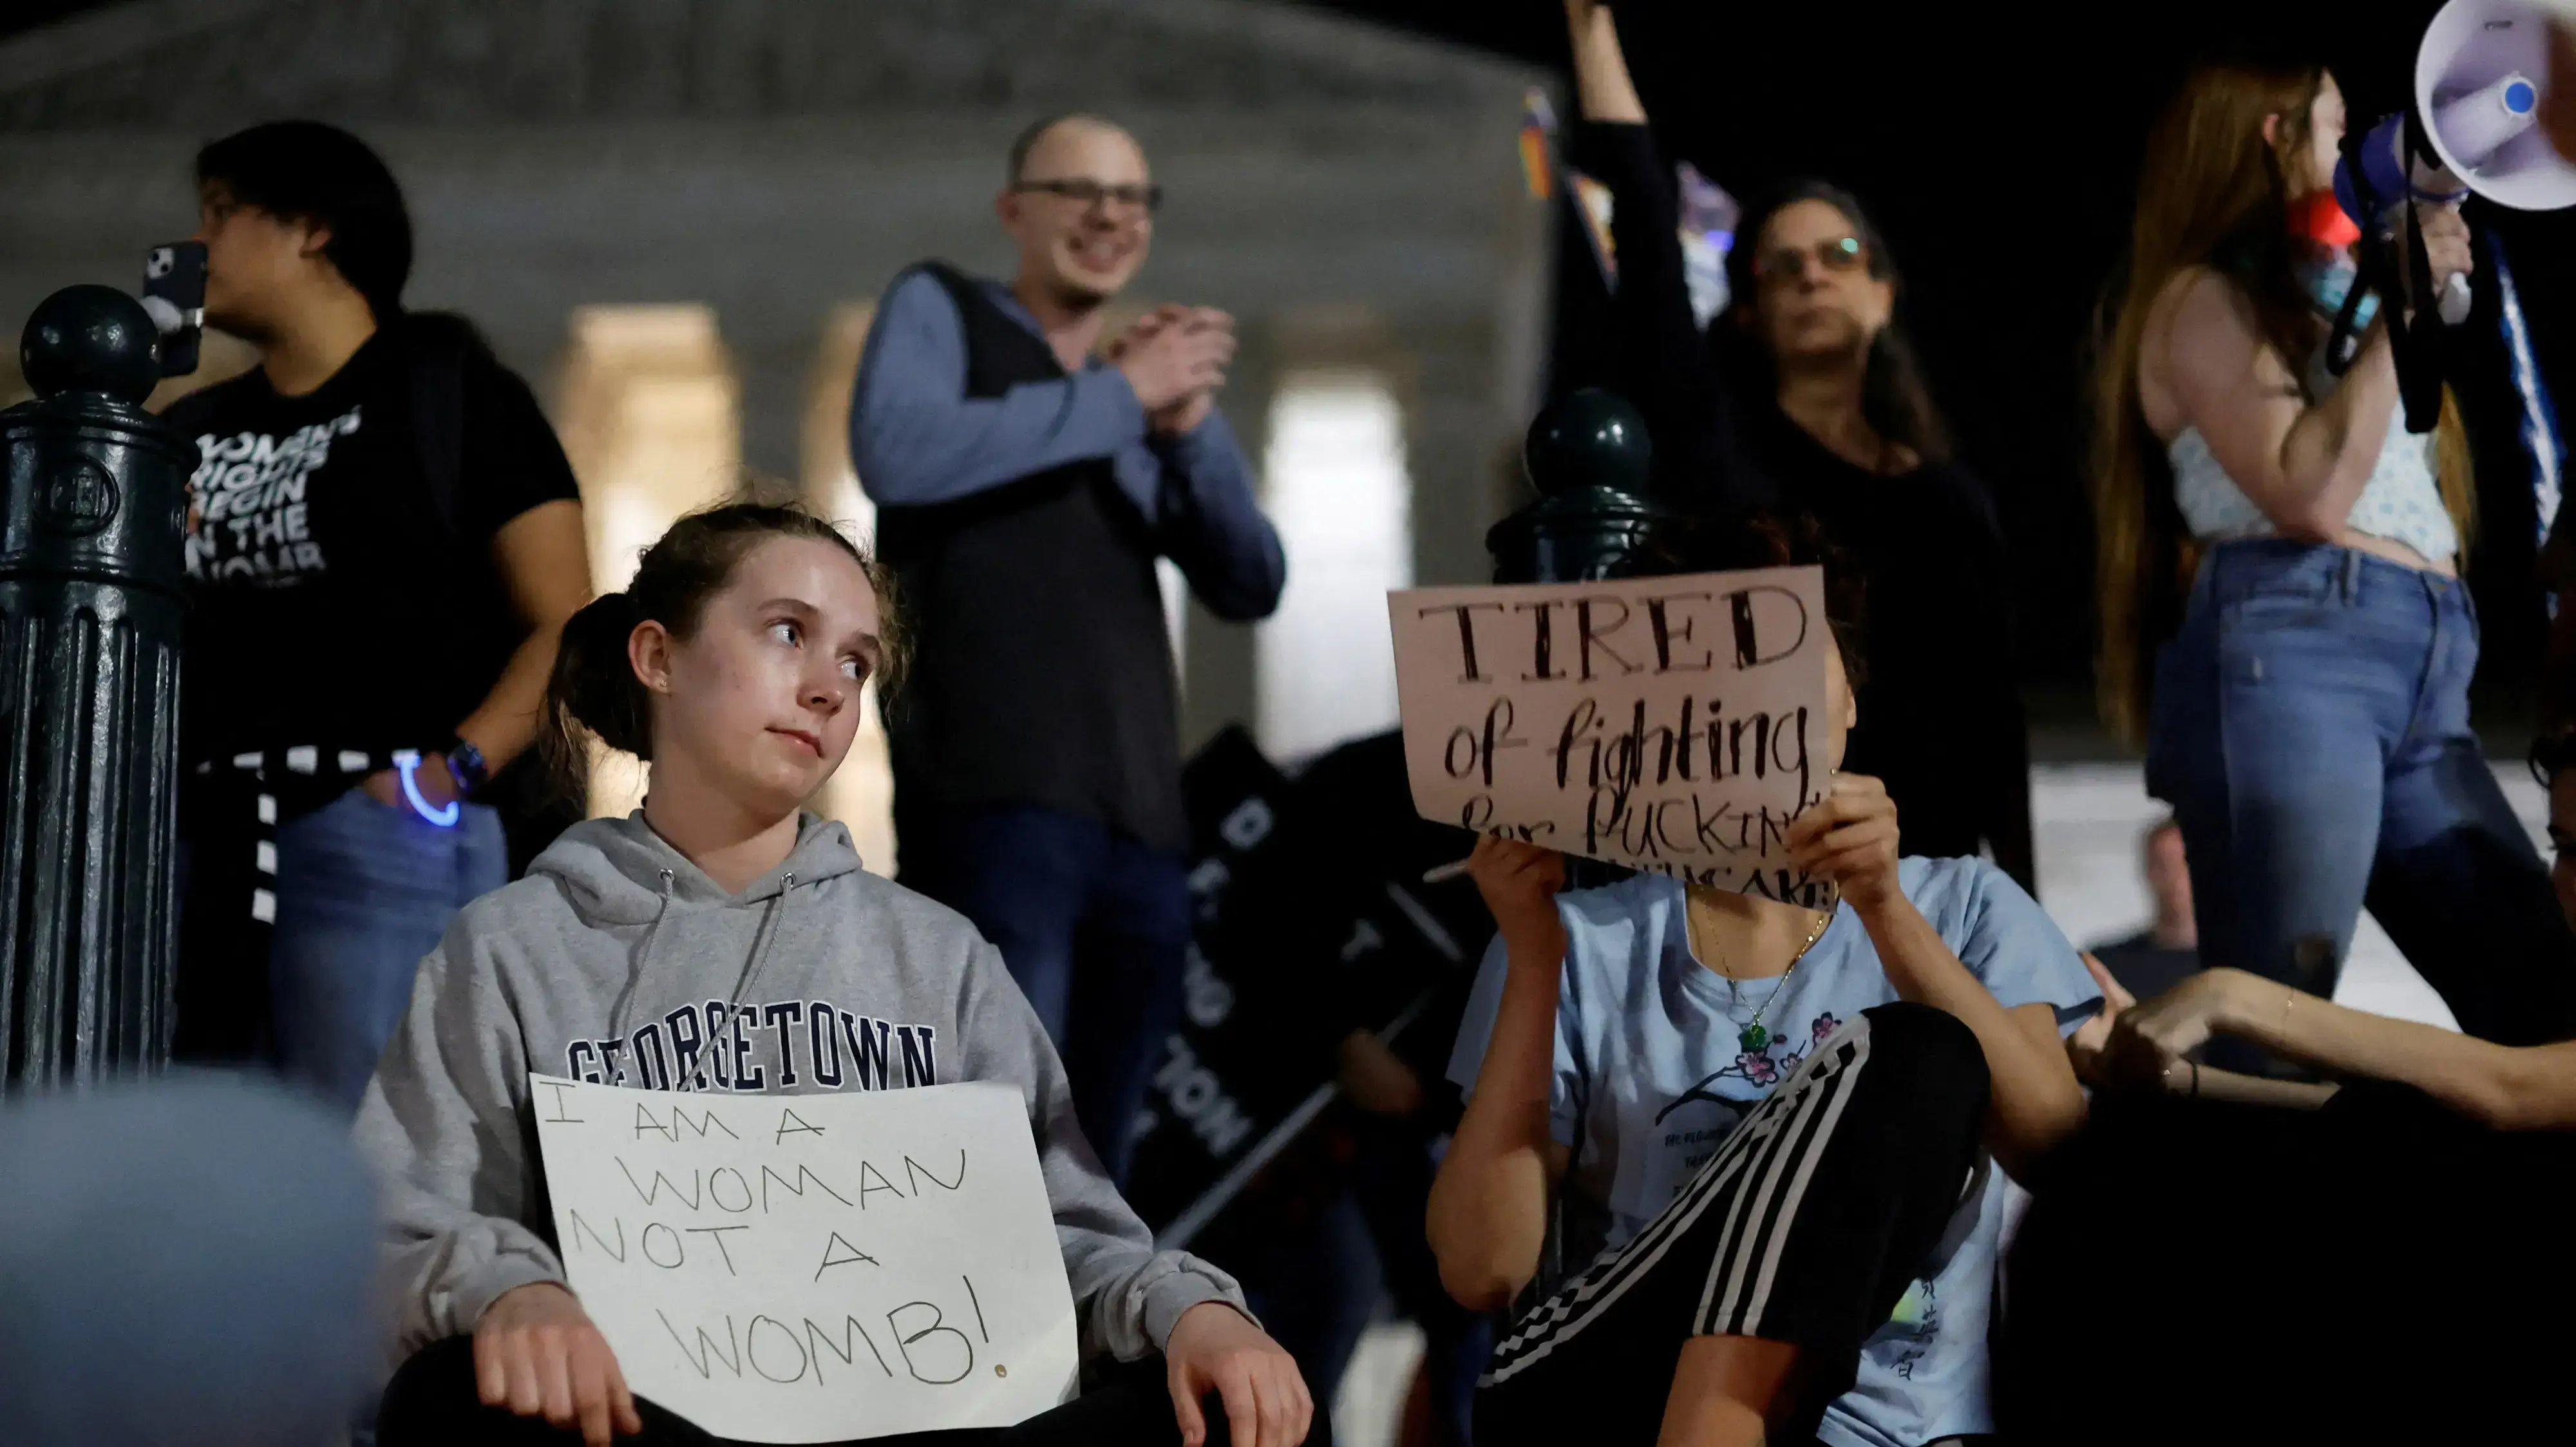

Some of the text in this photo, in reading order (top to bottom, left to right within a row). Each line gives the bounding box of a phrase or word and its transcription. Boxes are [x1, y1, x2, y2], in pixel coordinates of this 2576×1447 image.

[184, 501, 311, 571] N THE
[193, 542, 328, 580] OMB
[1419, 585, 1807, 684] TIRED
[1444, 695, 1808, 822] of fighting
[1462, 785, 1821, 858] for FUCKIN
[567, 1001, 936, 1092] GEORGETOWN
[538, 1081, 826, 1146] I AM A
[614, 1149, 965, 1215] WOMAN
[570, 1209, 880, 1282] NOT A
[656, 1275, 1007, 1387] WOMB!
